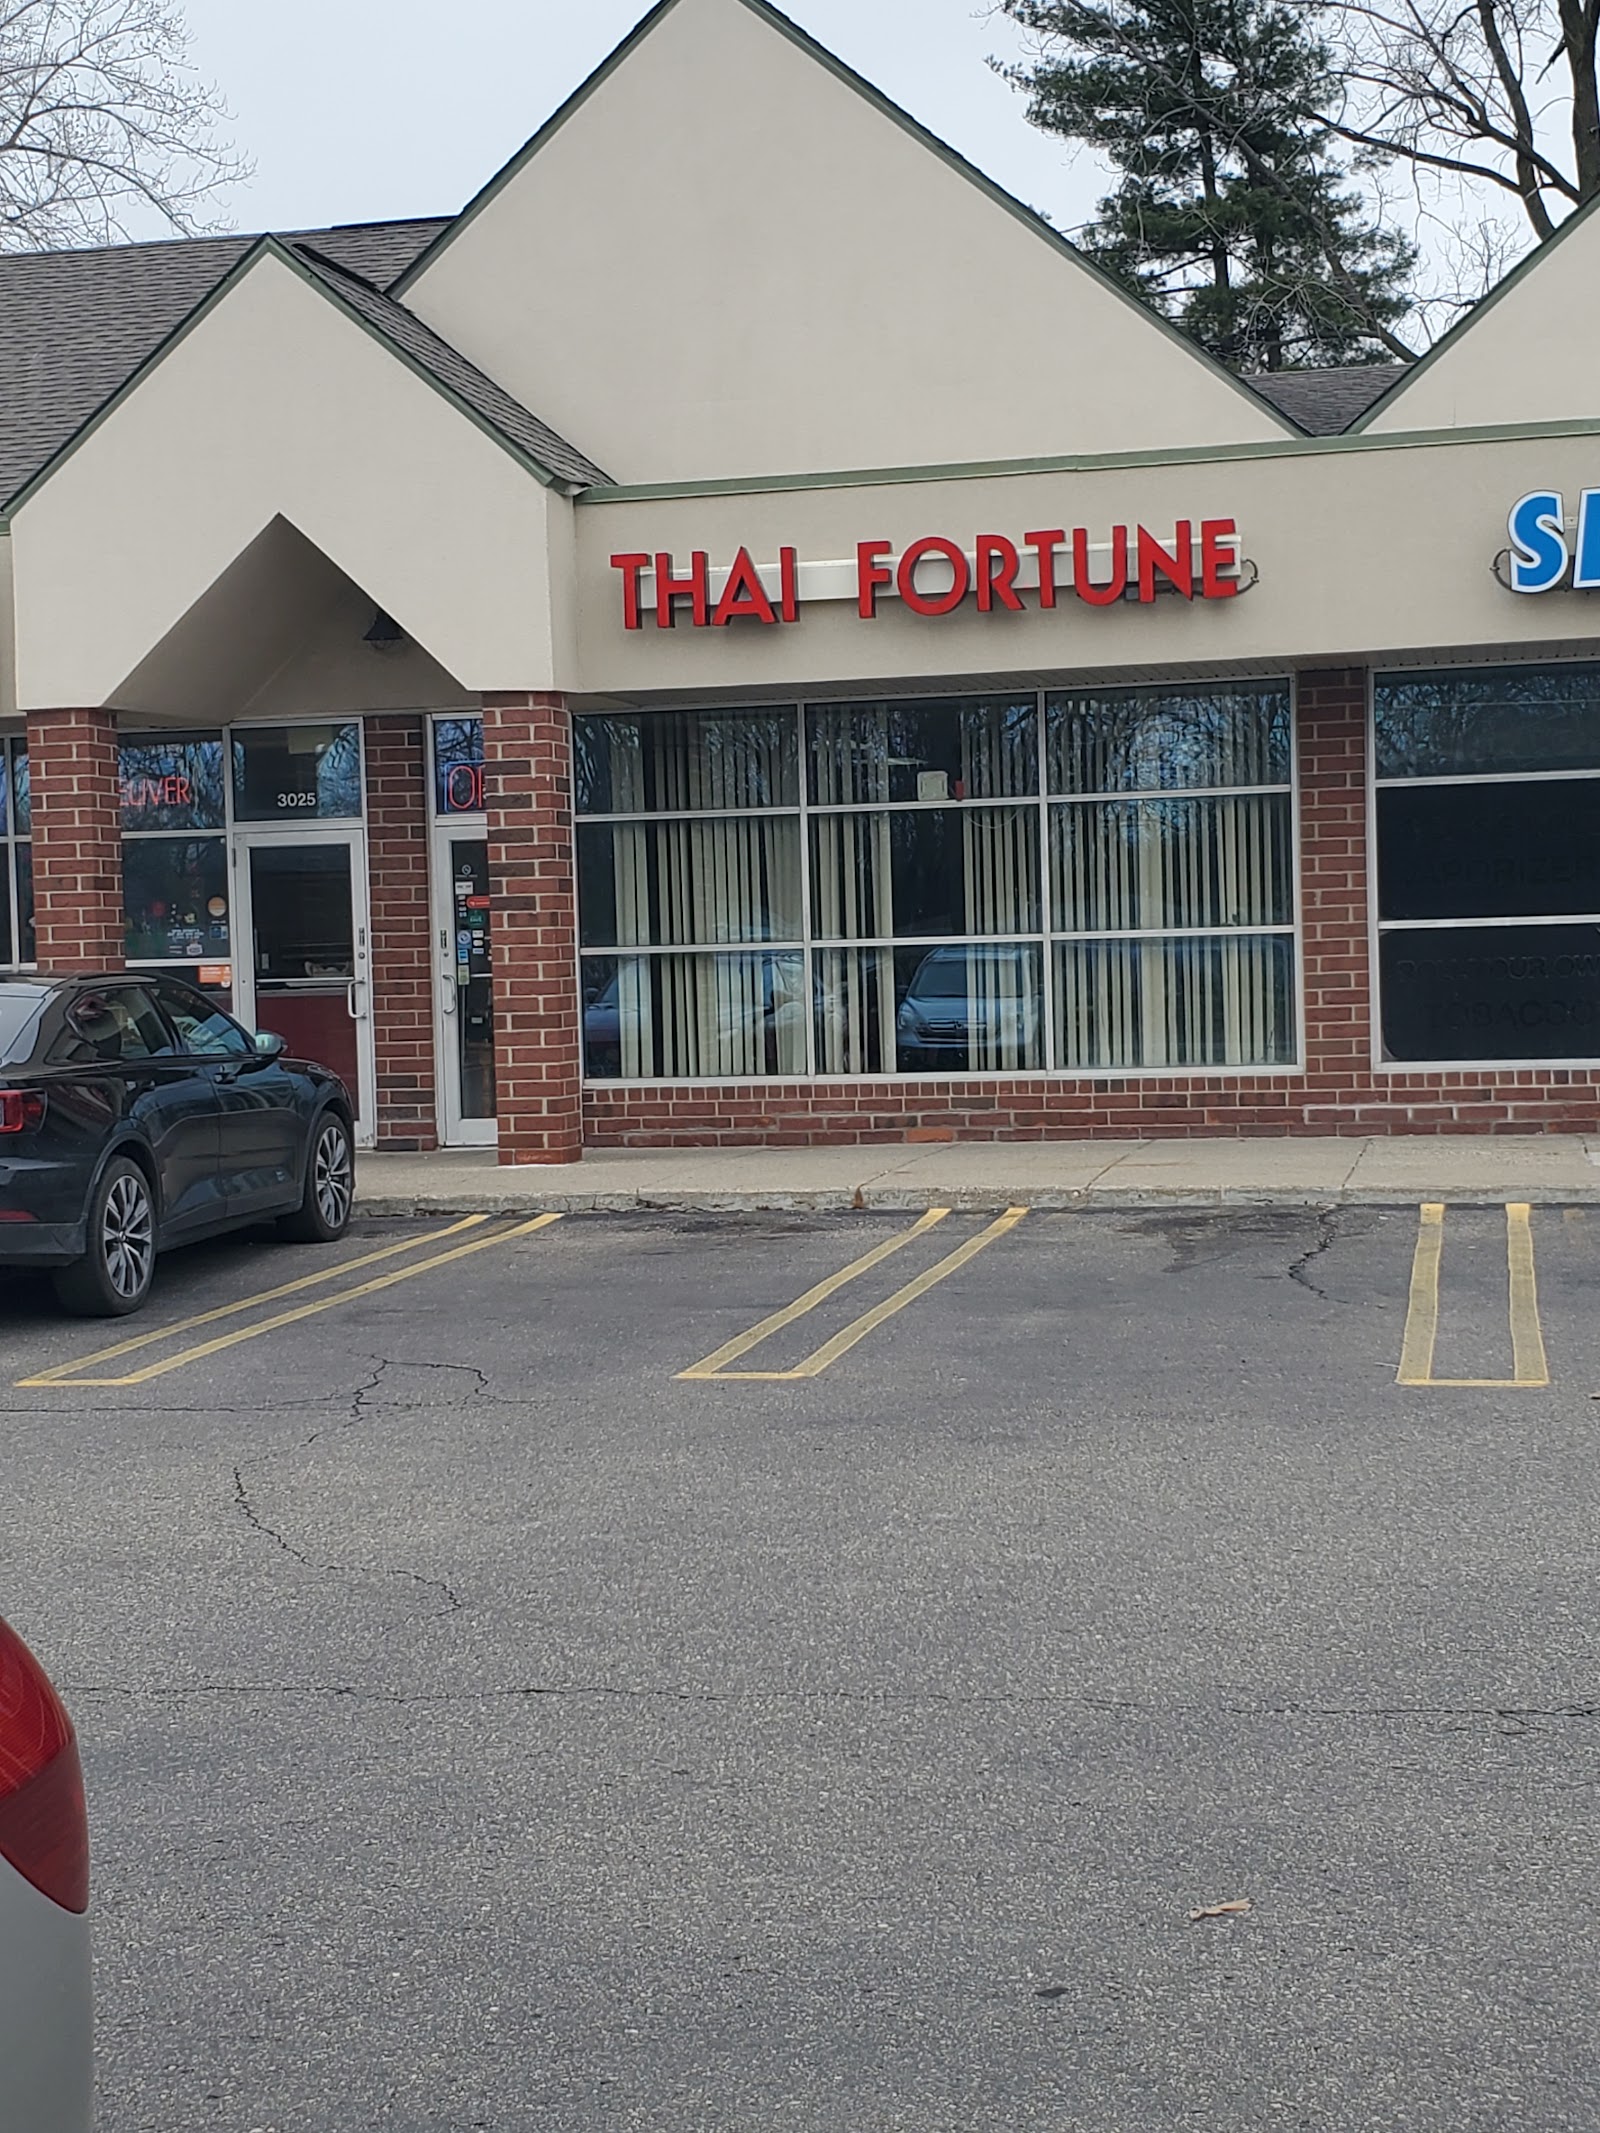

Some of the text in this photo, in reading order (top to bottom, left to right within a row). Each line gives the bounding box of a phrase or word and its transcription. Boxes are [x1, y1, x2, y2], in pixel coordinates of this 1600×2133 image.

[611, 519, 1240, 630] THAI FORTUNE
[277, 792, 317, 807] 3025
